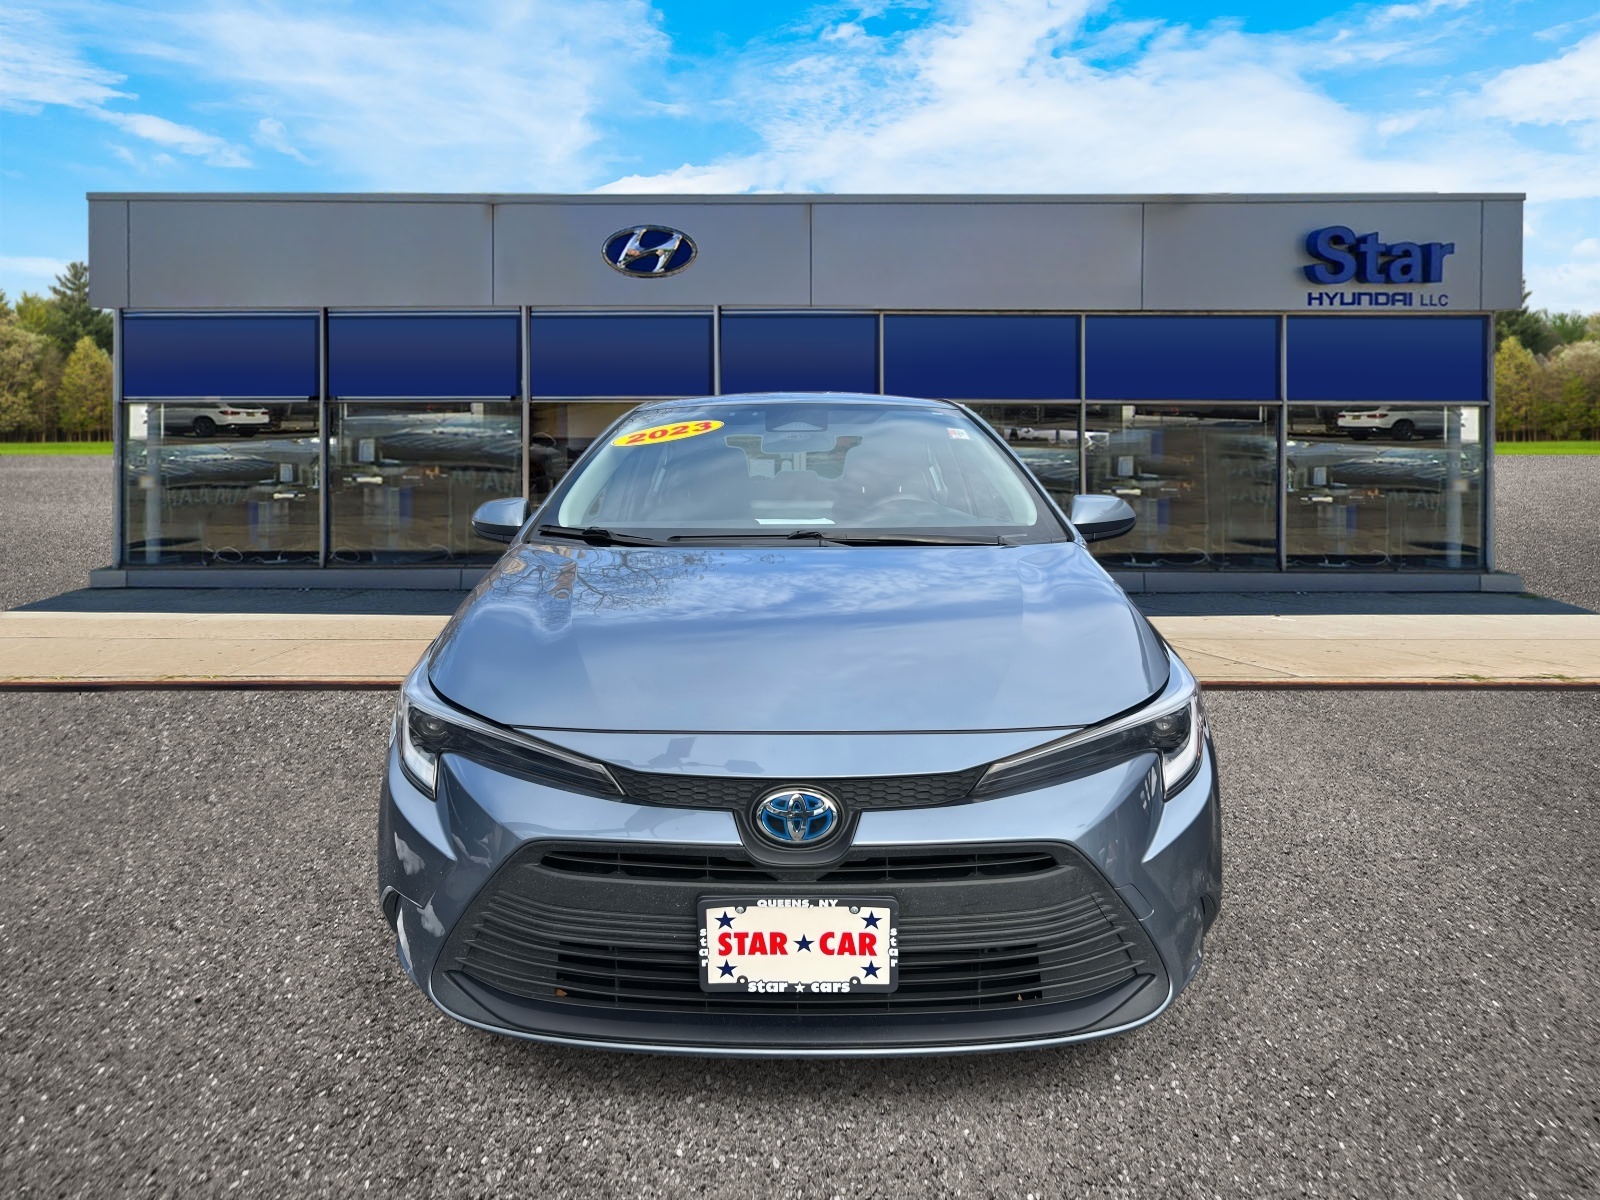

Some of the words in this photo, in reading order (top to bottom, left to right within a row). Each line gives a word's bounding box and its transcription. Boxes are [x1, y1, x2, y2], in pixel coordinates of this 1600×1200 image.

[1303, 225, 1455, 285] Star
[1307, 292, 1413, 306] HYUNDAI
[1420, 294, 1448, 306] LLC
[625, 421, 712, 444] 2023
[756, 899, 814, 908] QUEENS,
[818, 899, 838, 908] NY
[718, 931, 789, 956] STAR
[819, 931, 878, 956] CAR
[747, 980, 789, 993] star
[810, 980, 850, 993] cars
